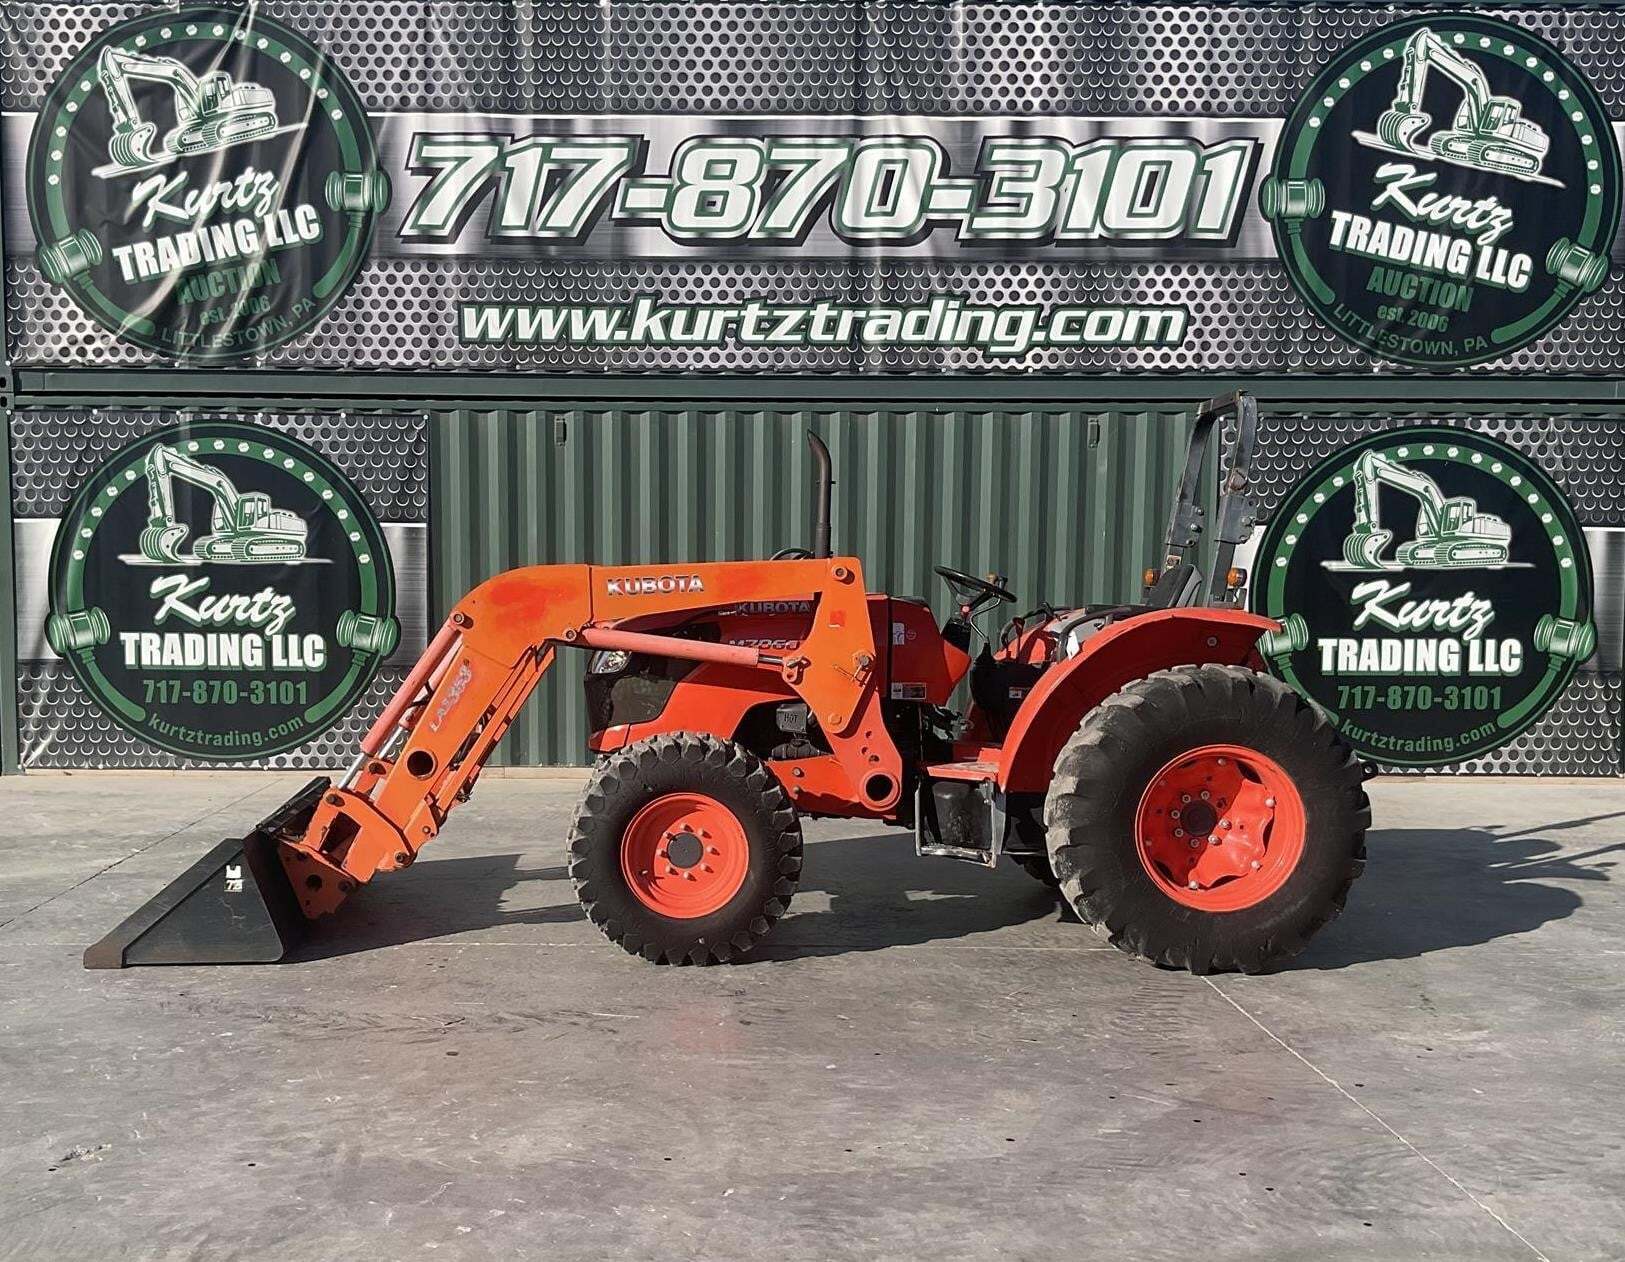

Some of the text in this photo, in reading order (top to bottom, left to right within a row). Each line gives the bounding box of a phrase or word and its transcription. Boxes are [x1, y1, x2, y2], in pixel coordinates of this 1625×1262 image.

[133, 167, 280, 231] Kurtz
[404, 136, 1254, 240] 717-870-3101
[1371, 162, 1513, 246] Kurtz
[112, 203, 323, 281] TRADING LLC
[1328, 210, 1534, 292] TRADING LLC
[177, 258, 281, 305] AUCTION
[1366, 266, 1474, 312] AUCTION
[292, 297, 316, 319] PA
[460, 292, 1188, 357] www.kurtztrading.com
[1333, 303, 1488, 355] LITTLESTOWN, PA
[1408, 310, 1449, 332] 2006
[149, 574, 297, 633] Kurtz
[606, 573, 704, 598] KUBOTA
[736, 602, 811, 614] KUBOTA
[1351, 580, 1495, 641] Kurtz
[119, 631, 327, 671] TRADING LLC
[1317, 637, 1522, 677] TRADING LLC
[143, 679, 308, 705] 717-870-3101
[1337, 685, 1502, 711] 717-870-3101
[148, 714, 305, 747] kurtztrading.com
[1340, 719, 1496, 752] kurtztrading.com
